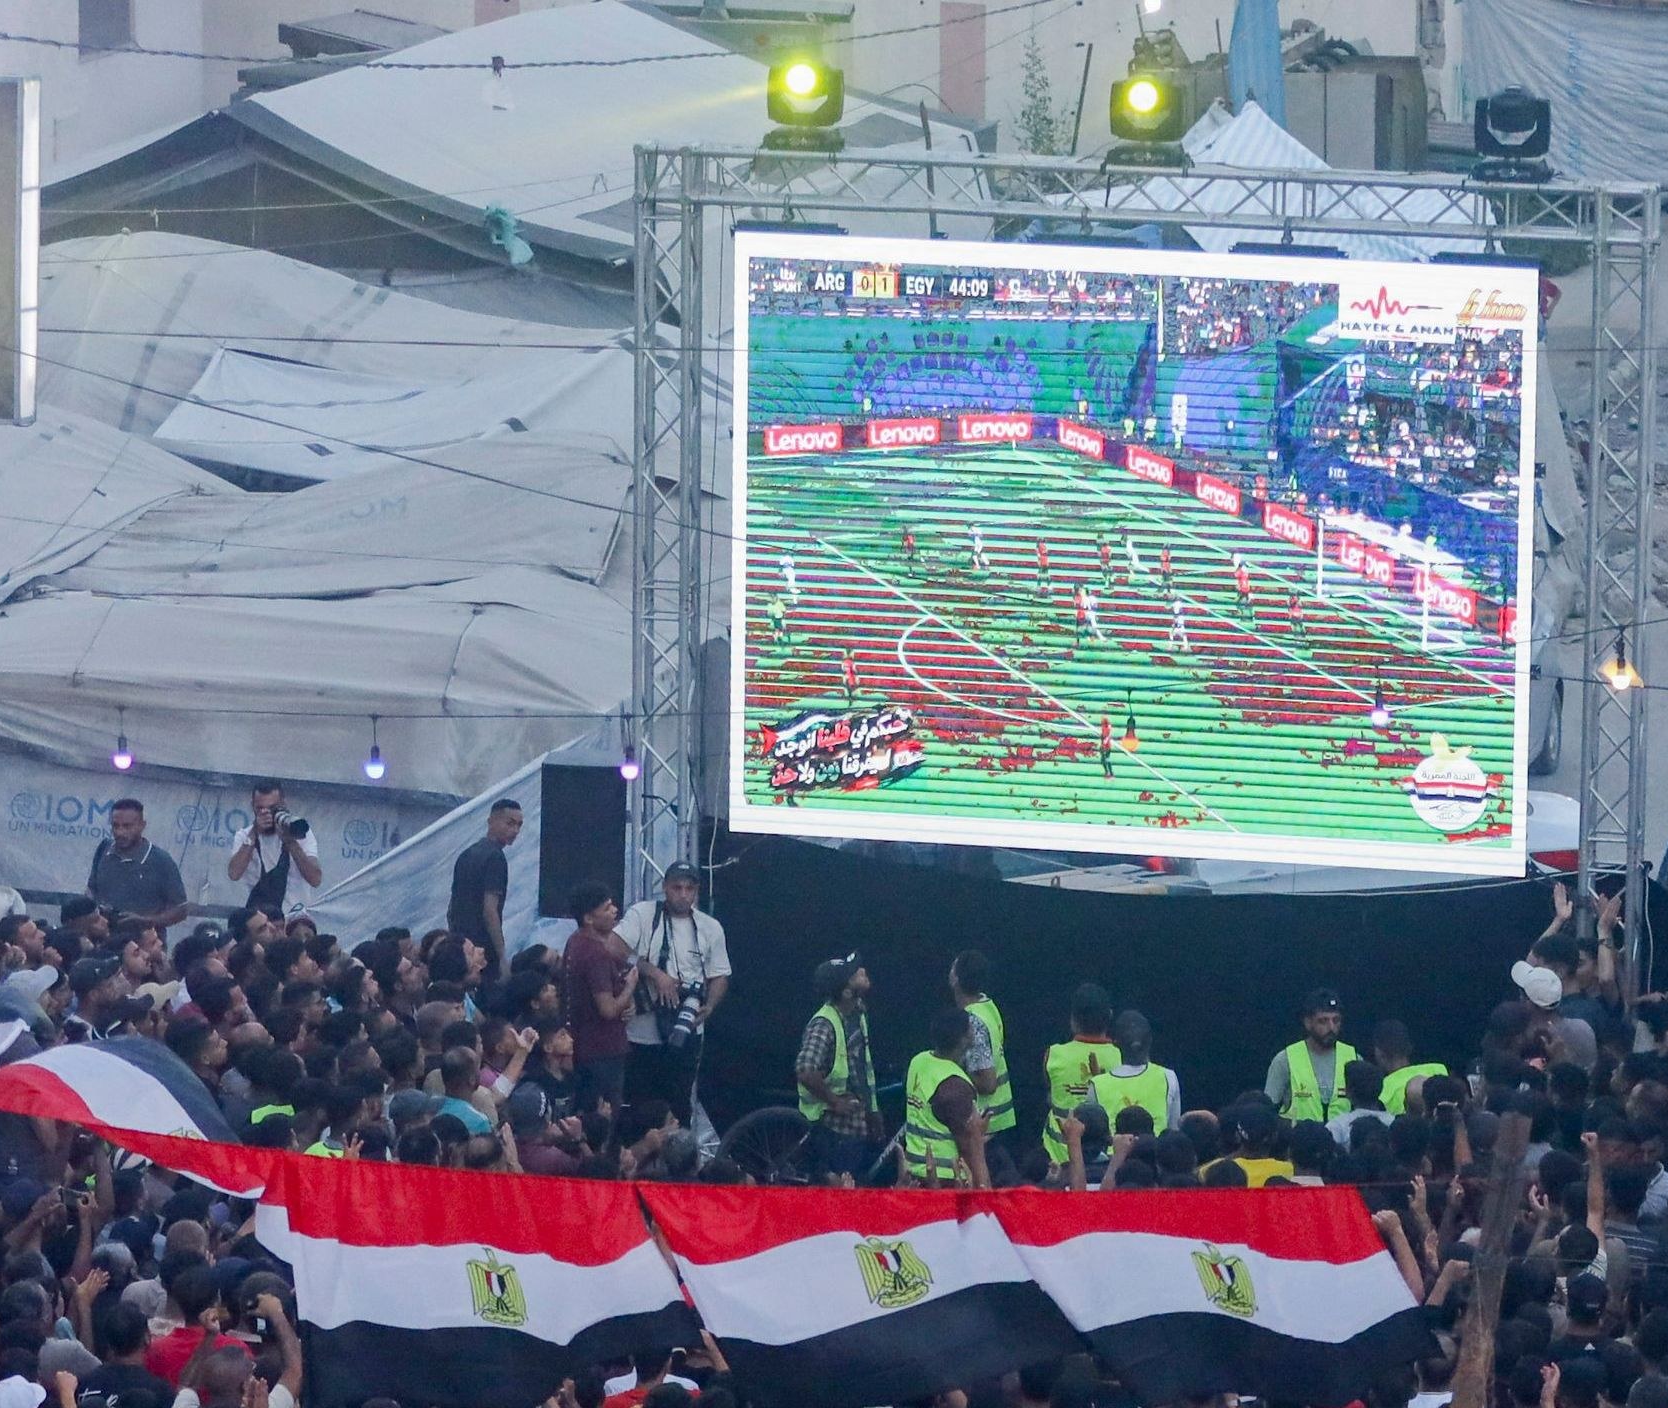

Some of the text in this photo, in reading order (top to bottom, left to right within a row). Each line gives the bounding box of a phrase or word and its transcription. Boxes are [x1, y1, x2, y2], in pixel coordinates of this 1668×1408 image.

[814, 272, 988, 297] ARG 0 1 EGY 44:09
[769, 431, 838, 452] Lenovo
[871, 424, 936, 446] Lenovo
[962, 418, 1029, 440] Lenovo
[1059, 420, 1101, 456] Lenovo
[1129, 449, 1172, 483] Lenovo
[1266, 506, 1309, 544] Lenovo
[46, 794, 116, 825] IOM
[213, 807, 249, 836] IO
[8, 820, 31, 833] UN
